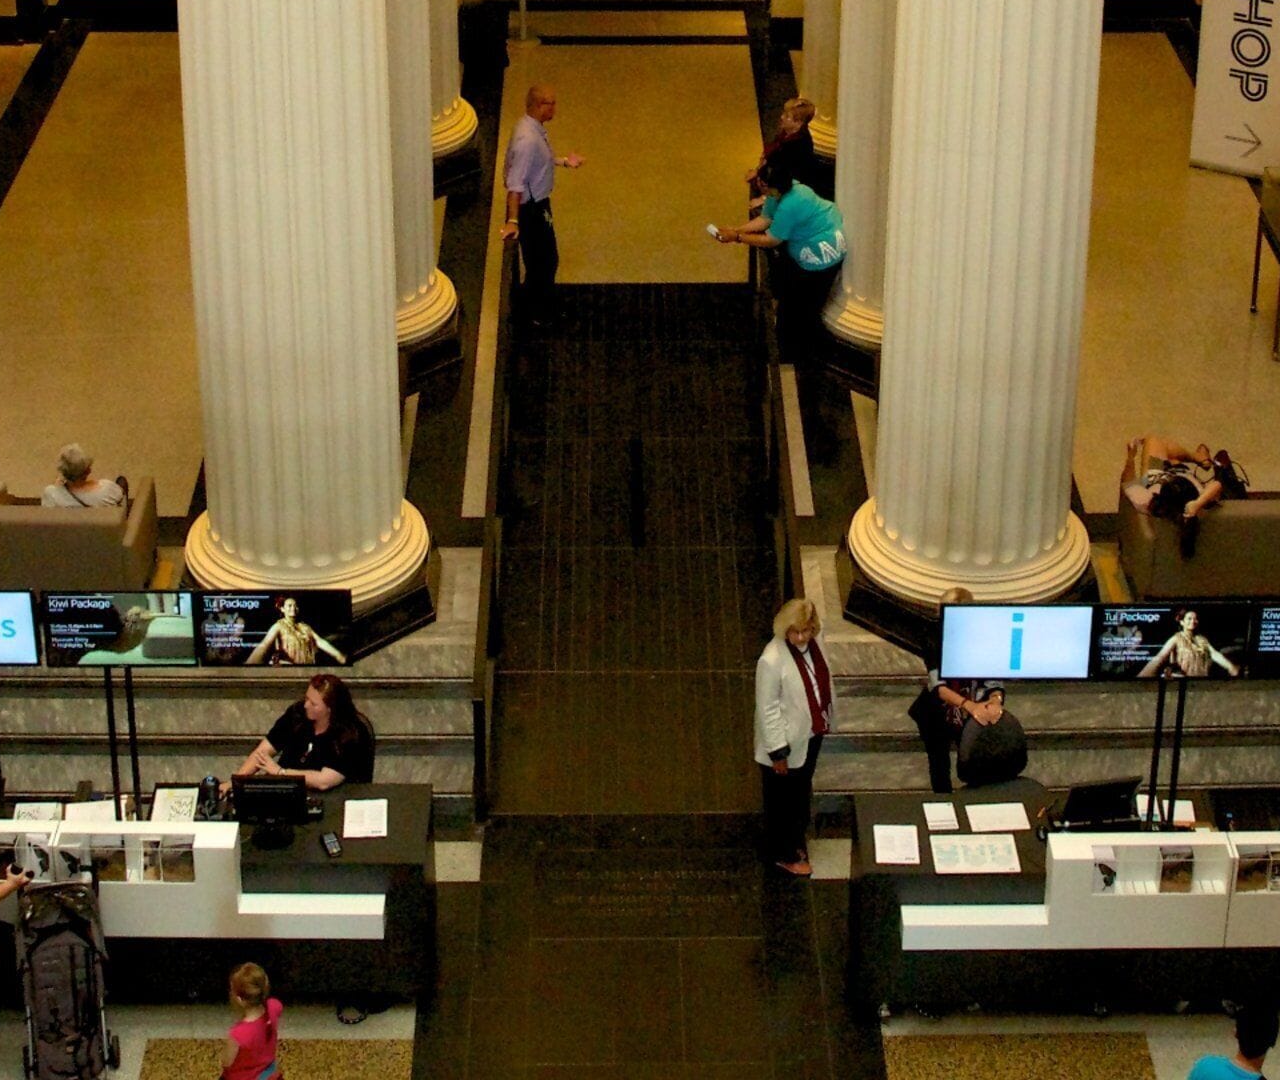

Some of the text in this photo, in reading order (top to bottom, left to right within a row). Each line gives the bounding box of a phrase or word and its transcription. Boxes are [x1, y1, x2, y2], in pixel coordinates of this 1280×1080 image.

[48, 600, 69, 608] Kiwi
[71, 599, 111, 610] Package
[204, 600, 218, 608] Tui
[220, 599, 260, 610] Package
[1104, 612, 1160, 623] Tui Package
